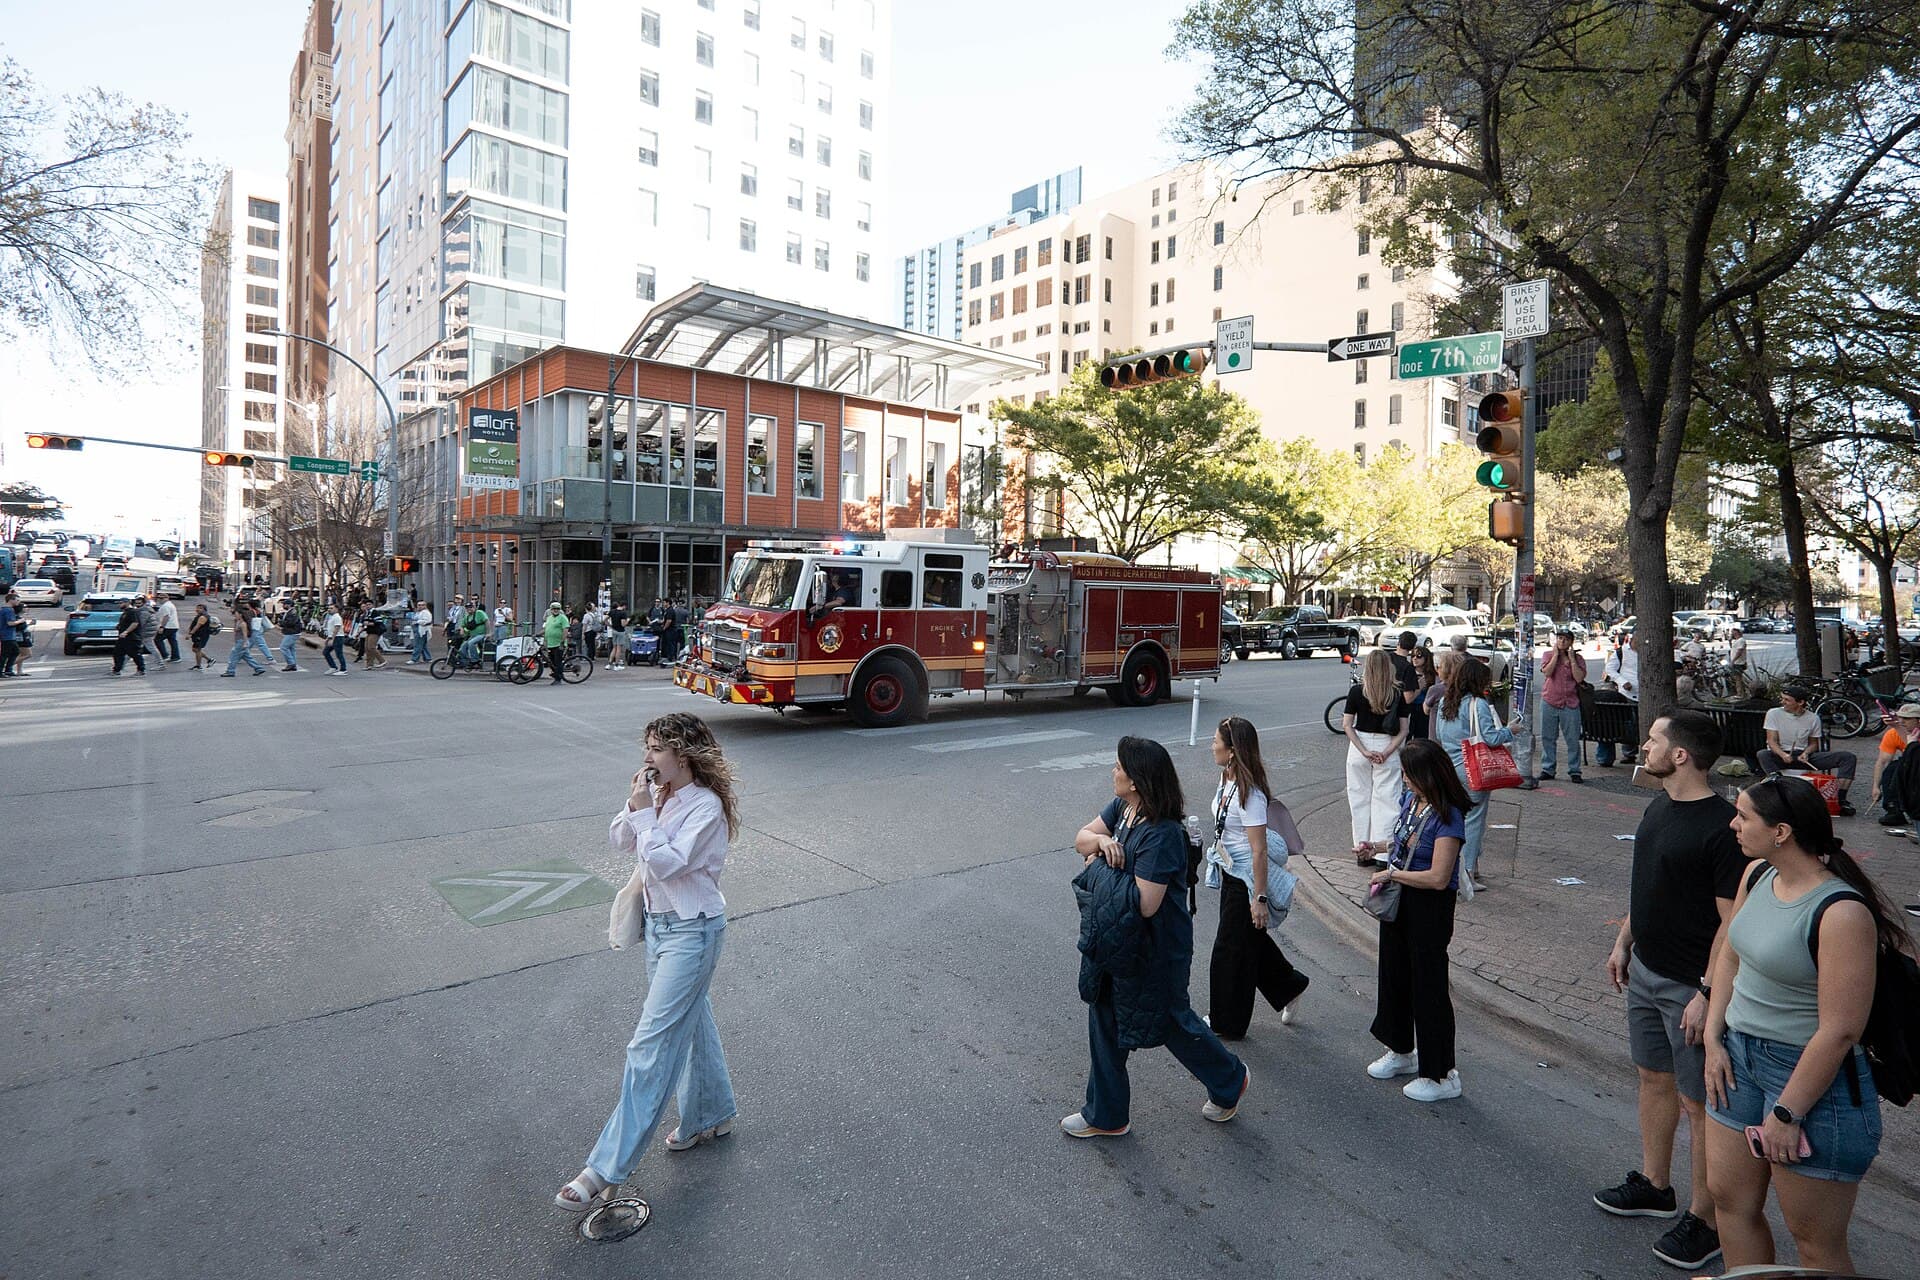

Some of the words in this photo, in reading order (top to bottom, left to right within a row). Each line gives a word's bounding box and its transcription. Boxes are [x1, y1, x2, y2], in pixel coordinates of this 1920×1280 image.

[1511, 284, 1541, 296] BIKES
[1514, 294, 1537, 305] MAY
[1515, 304, 1536, 315] USE
[1515, 314, 1536, 325] PED
[1219, 324, 1231, 332] LEFT
[1237, 320, 1251, 328] TURN
[1507, 323, 1545, 336] SIGNAL
[1225, 330, 1245, 341] YIELD
[1220, 344, 1228, 352] ON
[1230, 341, 1250, 350] GREEN
[1347, 342, 1366, 353] ONE
[1368, 339, 1388, 350] WAY
[1479, 341, 1493, 352] ST
[1401, 361, 1423, 374] 100E
[1430, 346, 1466, 369] 7th
[1472, 353, 1498, 366] 100W
[473, 414, 516, 431] aloft
[306, 461, 335, 470] Congress
[472, 456, 516, 466] element
[464, 475, 502, 486] UPSTAIRS
[1076, 567, 1103, 577] AUSTIN
[1104, 568, 1121, 578] FIRE
[1123, 569, 1166, 580] DEPARTMENT
[1195, 611, 1205, 629] 1
[770, 628, 780, 641] 1
[938, 632, 945, 643] 1
